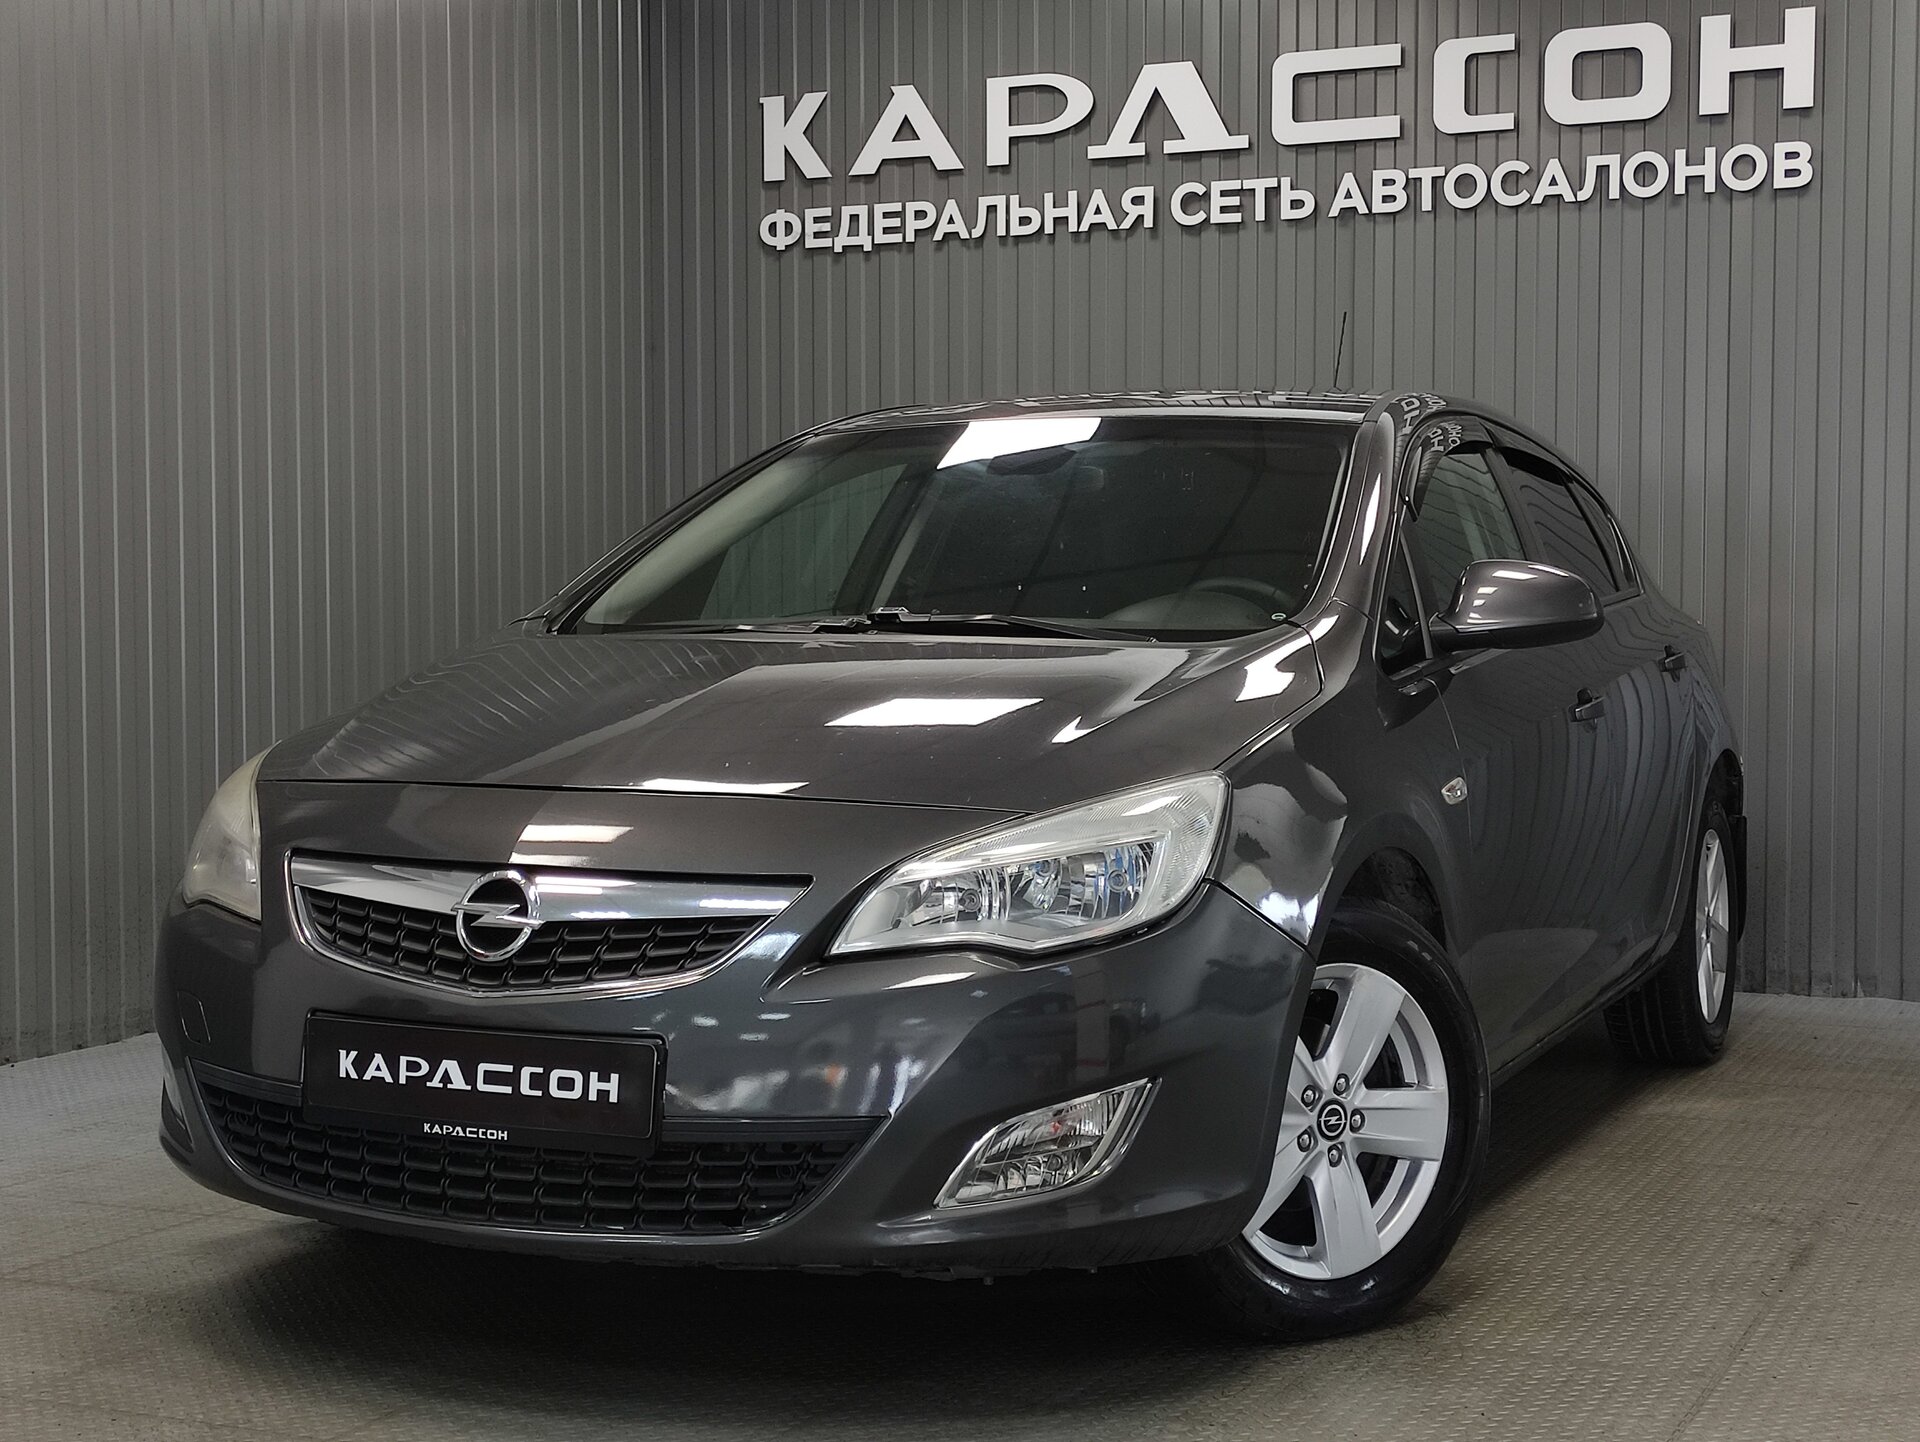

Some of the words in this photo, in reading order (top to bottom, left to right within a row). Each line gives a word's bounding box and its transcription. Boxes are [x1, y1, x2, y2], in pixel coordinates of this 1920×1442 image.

[759, 185, 1155, 253] ФЕДЕРАЛЬНАЯ
[1170, 176, 1316, 226] СЕТЬ
[1327, 140, 1814, 218] АВТОСАЛОНОВ
